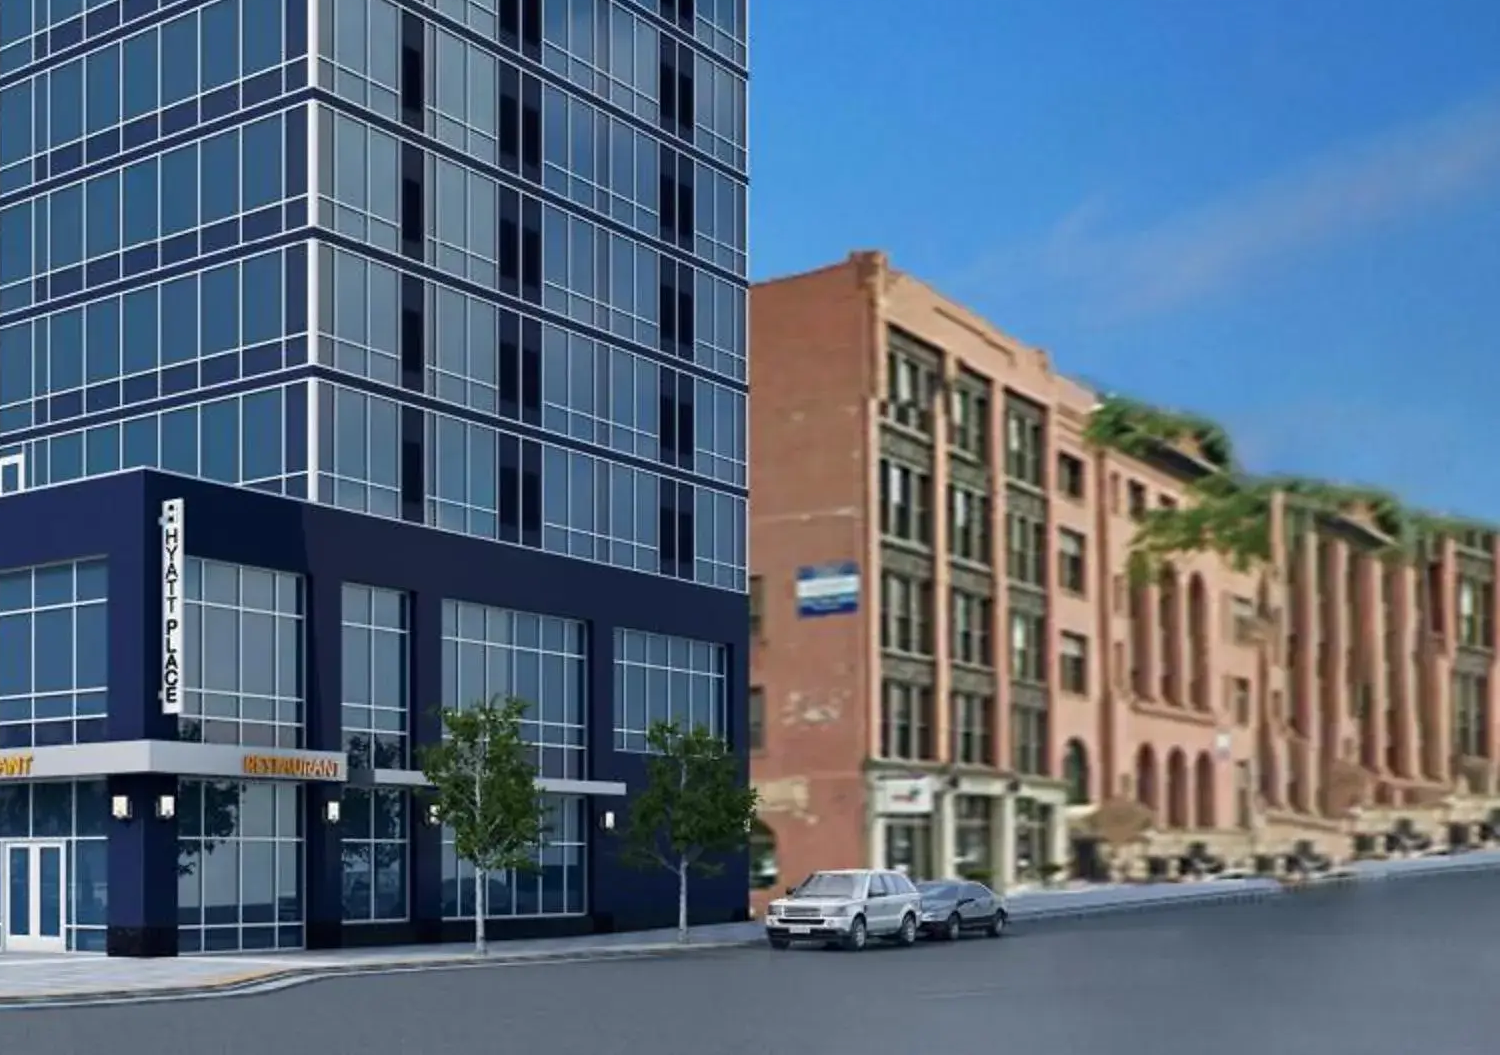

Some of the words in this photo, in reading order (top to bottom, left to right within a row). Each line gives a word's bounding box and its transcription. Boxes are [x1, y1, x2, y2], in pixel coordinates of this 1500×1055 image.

[165, 528, 179, 614] HYATT
[165, 618, 179, 704] PLACE
[243, 754, 340, 777] RESTAURANT
